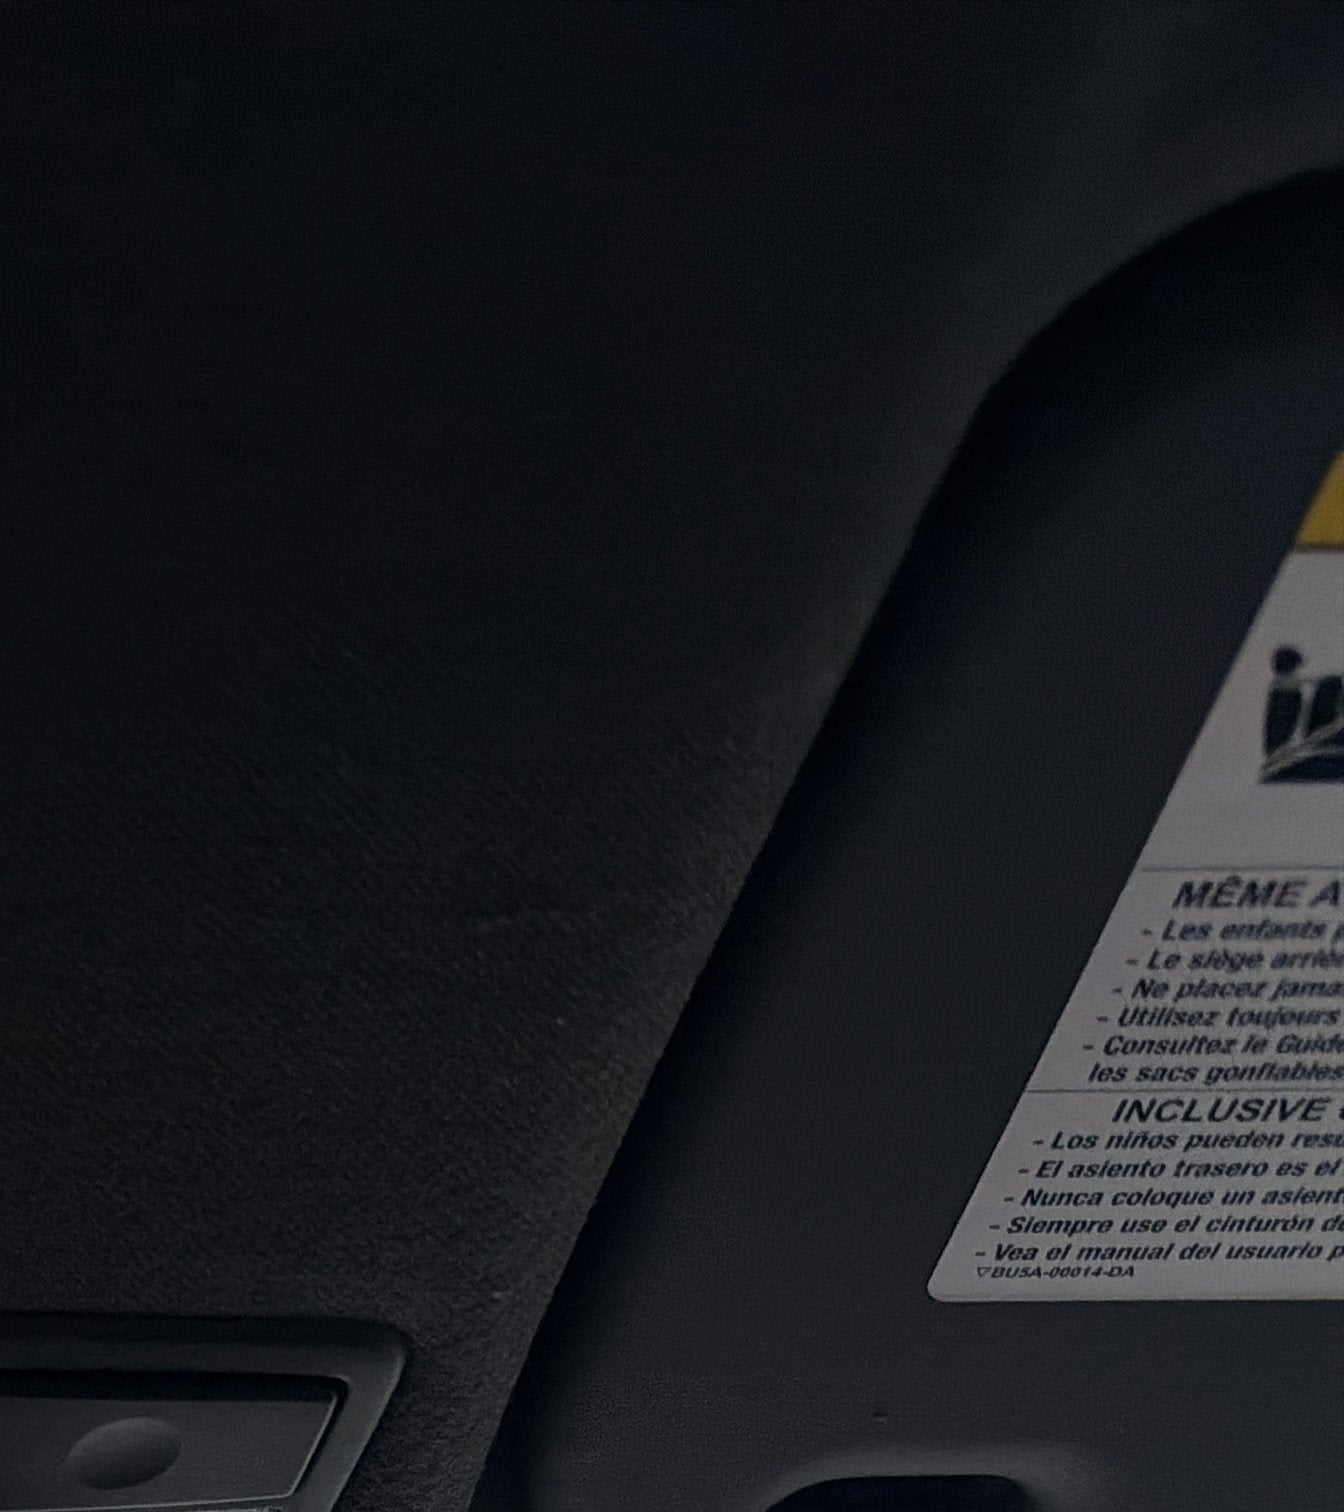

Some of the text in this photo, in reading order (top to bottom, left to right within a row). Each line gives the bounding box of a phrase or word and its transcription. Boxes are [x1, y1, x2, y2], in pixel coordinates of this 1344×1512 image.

[1172, 875, 1308, 908] MÊME
[1161, 919, 1212, 941] Les
[1146, 950, 1181, 971] Le
[1131, 978, 1170, 999] Ne
[1173, 978, 1268, 1002] placez
[1118, 1006, 1221, 1028] Utilisez
[1103, 1035, 1237, 1056] Consultez
[1241, 1035, 1270, 1055] le
[1088, 1062, 1128, 1083] les
[1135, 1065, 1199, 1083] sacs
[1111, 1097, 1332, 1123] INCLUSIVE
[1050, 1131, 1098, 1150] Los
[1105, 1131, 1178, 1150] niños
[1183, 1130, 1285, 1152] pueden
[1035, 1160, 1063, 1178] El
[1067, 1160, 1166, 1178] asiento
[1172, 1160, 1269, 1178] trasero
[1275, 1161, 1308, 1178] es
[1020, 1188, 1104, 1207] Nunca
[1110, 1188, 1215, 1210] coloque
[1221, 1190, 1255, 1206] un
[1007, 1216, 1114, 1237] Siempre
[1120, 1219, 1170, 1234] use
[1174, 1215, 1200, 1234] el
[993, 1243, 1038, 1262] Vea
[1045, 1243, 1070, 1261] el
[1075, 1243, 1173, 1261] manual
[1178, 1242, 1220, 1261] del
[1225, 1241, 1325, 1260] usuario
